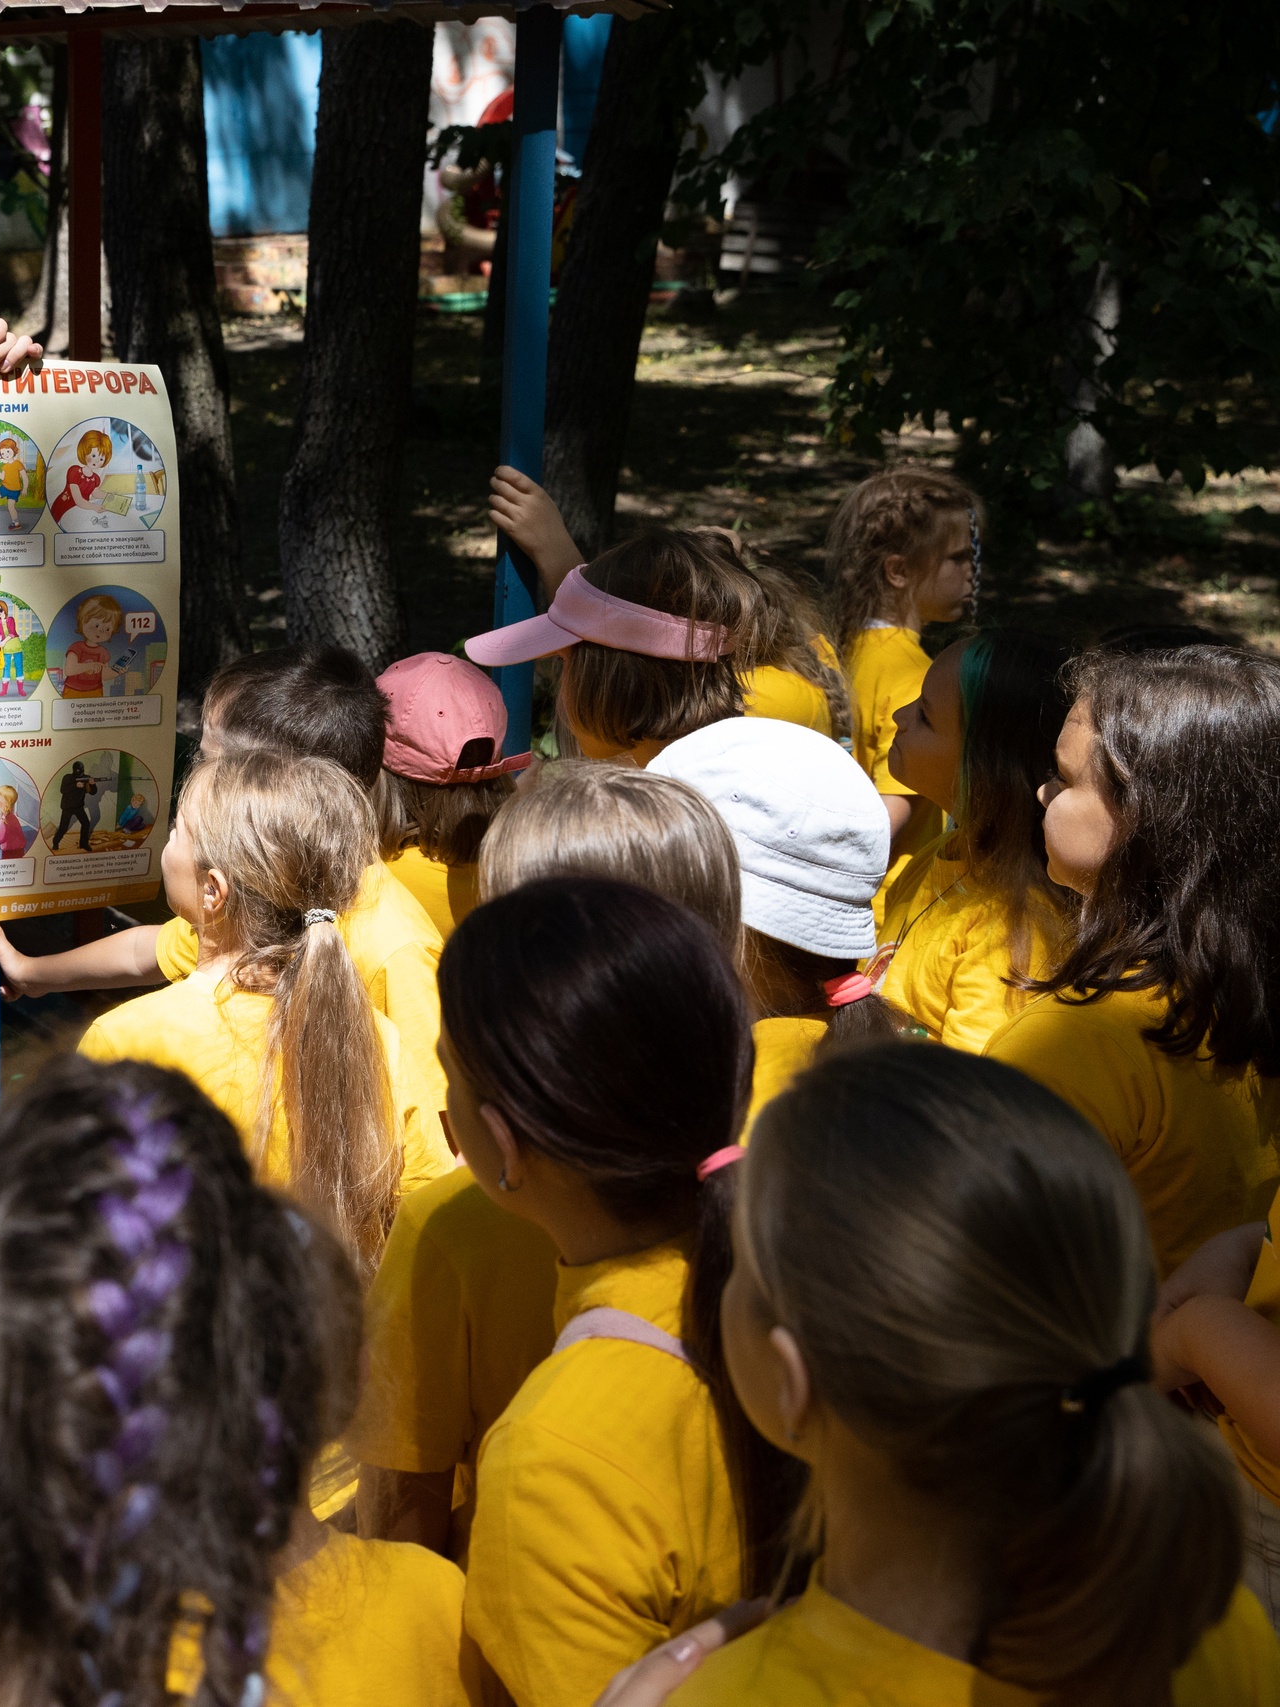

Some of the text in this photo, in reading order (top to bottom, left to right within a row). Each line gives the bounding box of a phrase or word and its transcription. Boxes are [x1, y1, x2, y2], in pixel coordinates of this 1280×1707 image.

[130, 617, 150, 629] 112
[76, 700, 117, 709] чрезвычайной
[122, 713, 141, 721] звони!
[10, 738, 52, 749] жизни
[104, 867, 134, 875] террориста
[1, 905, 8, 914] в
[11, 902, 39, 913] беду
[41, 900, 55, 910] не
[58, 893, 112, 907] попадай!
